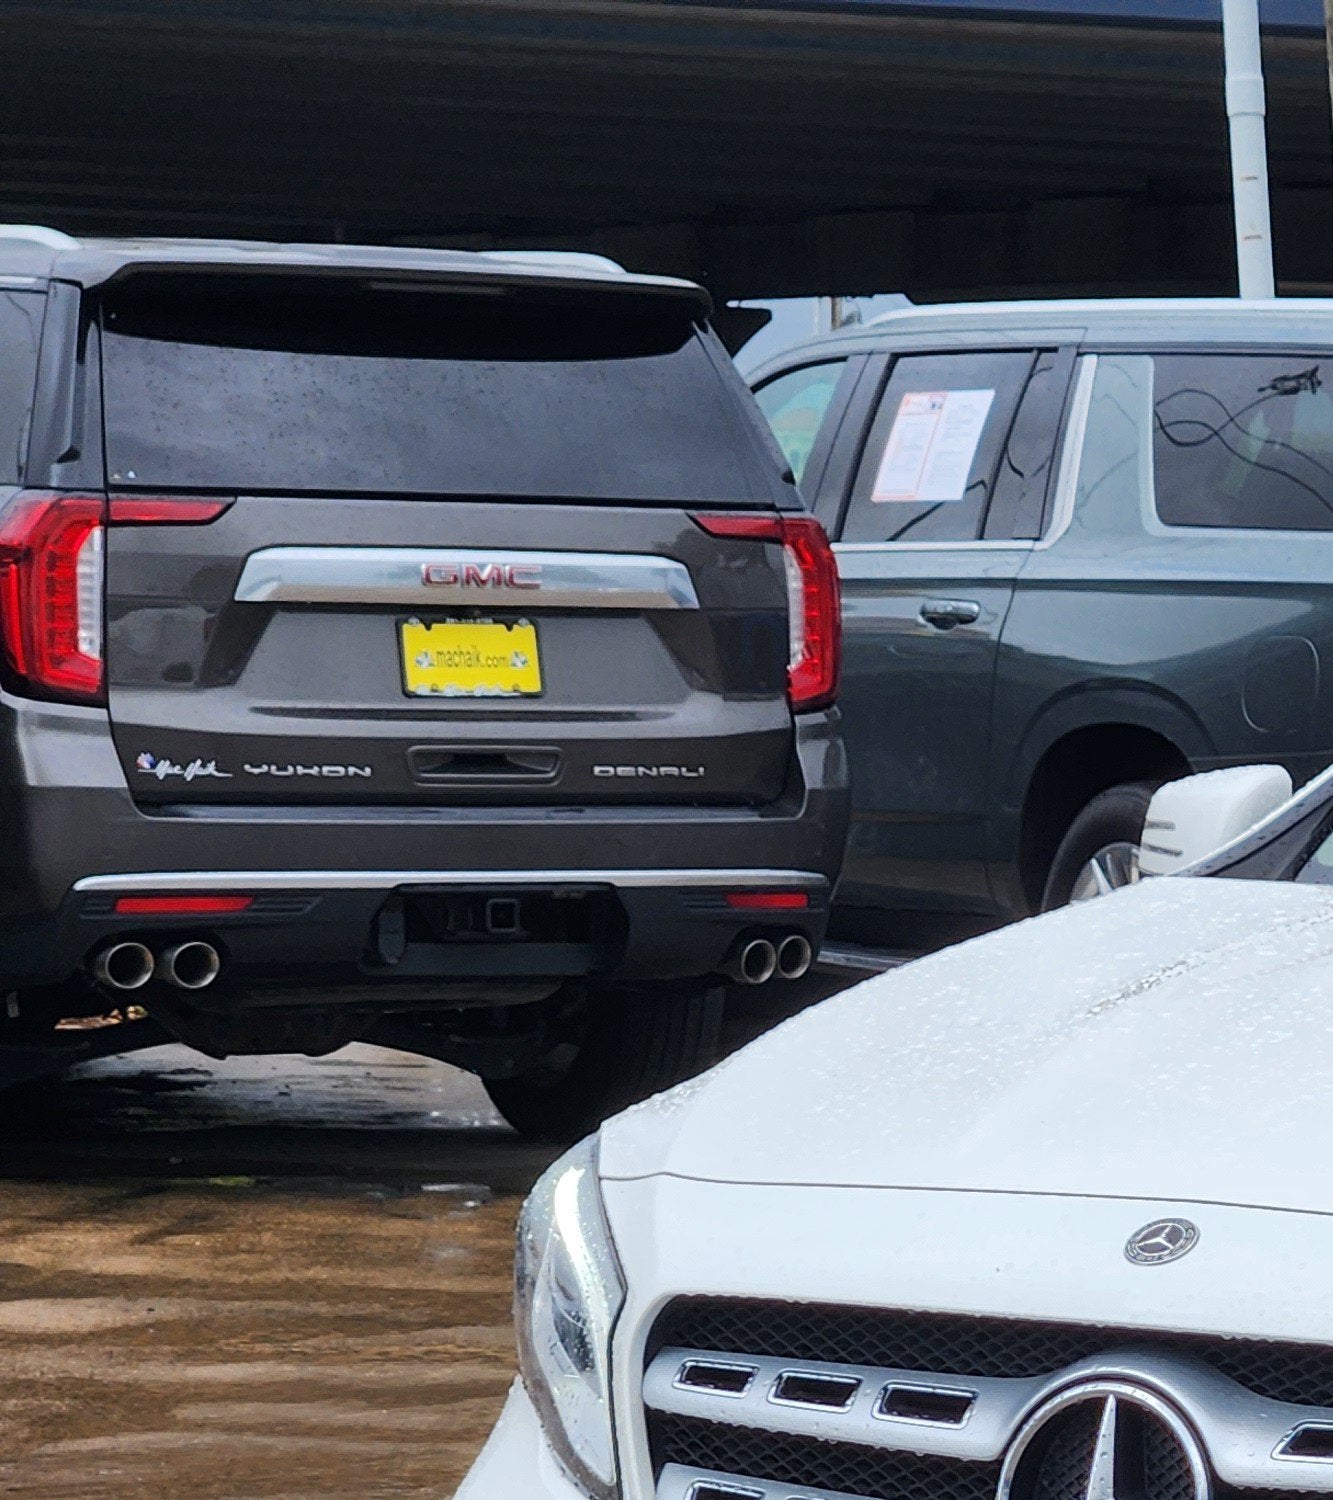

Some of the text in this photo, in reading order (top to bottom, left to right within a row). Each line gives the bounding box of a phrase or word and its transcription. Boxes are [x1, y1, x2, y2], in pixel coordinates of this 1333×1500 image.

[421, 563, 542, 589] GMC
[243, 764, 372, 777] YUKON
[593, 766, 704, 777] DENALI
